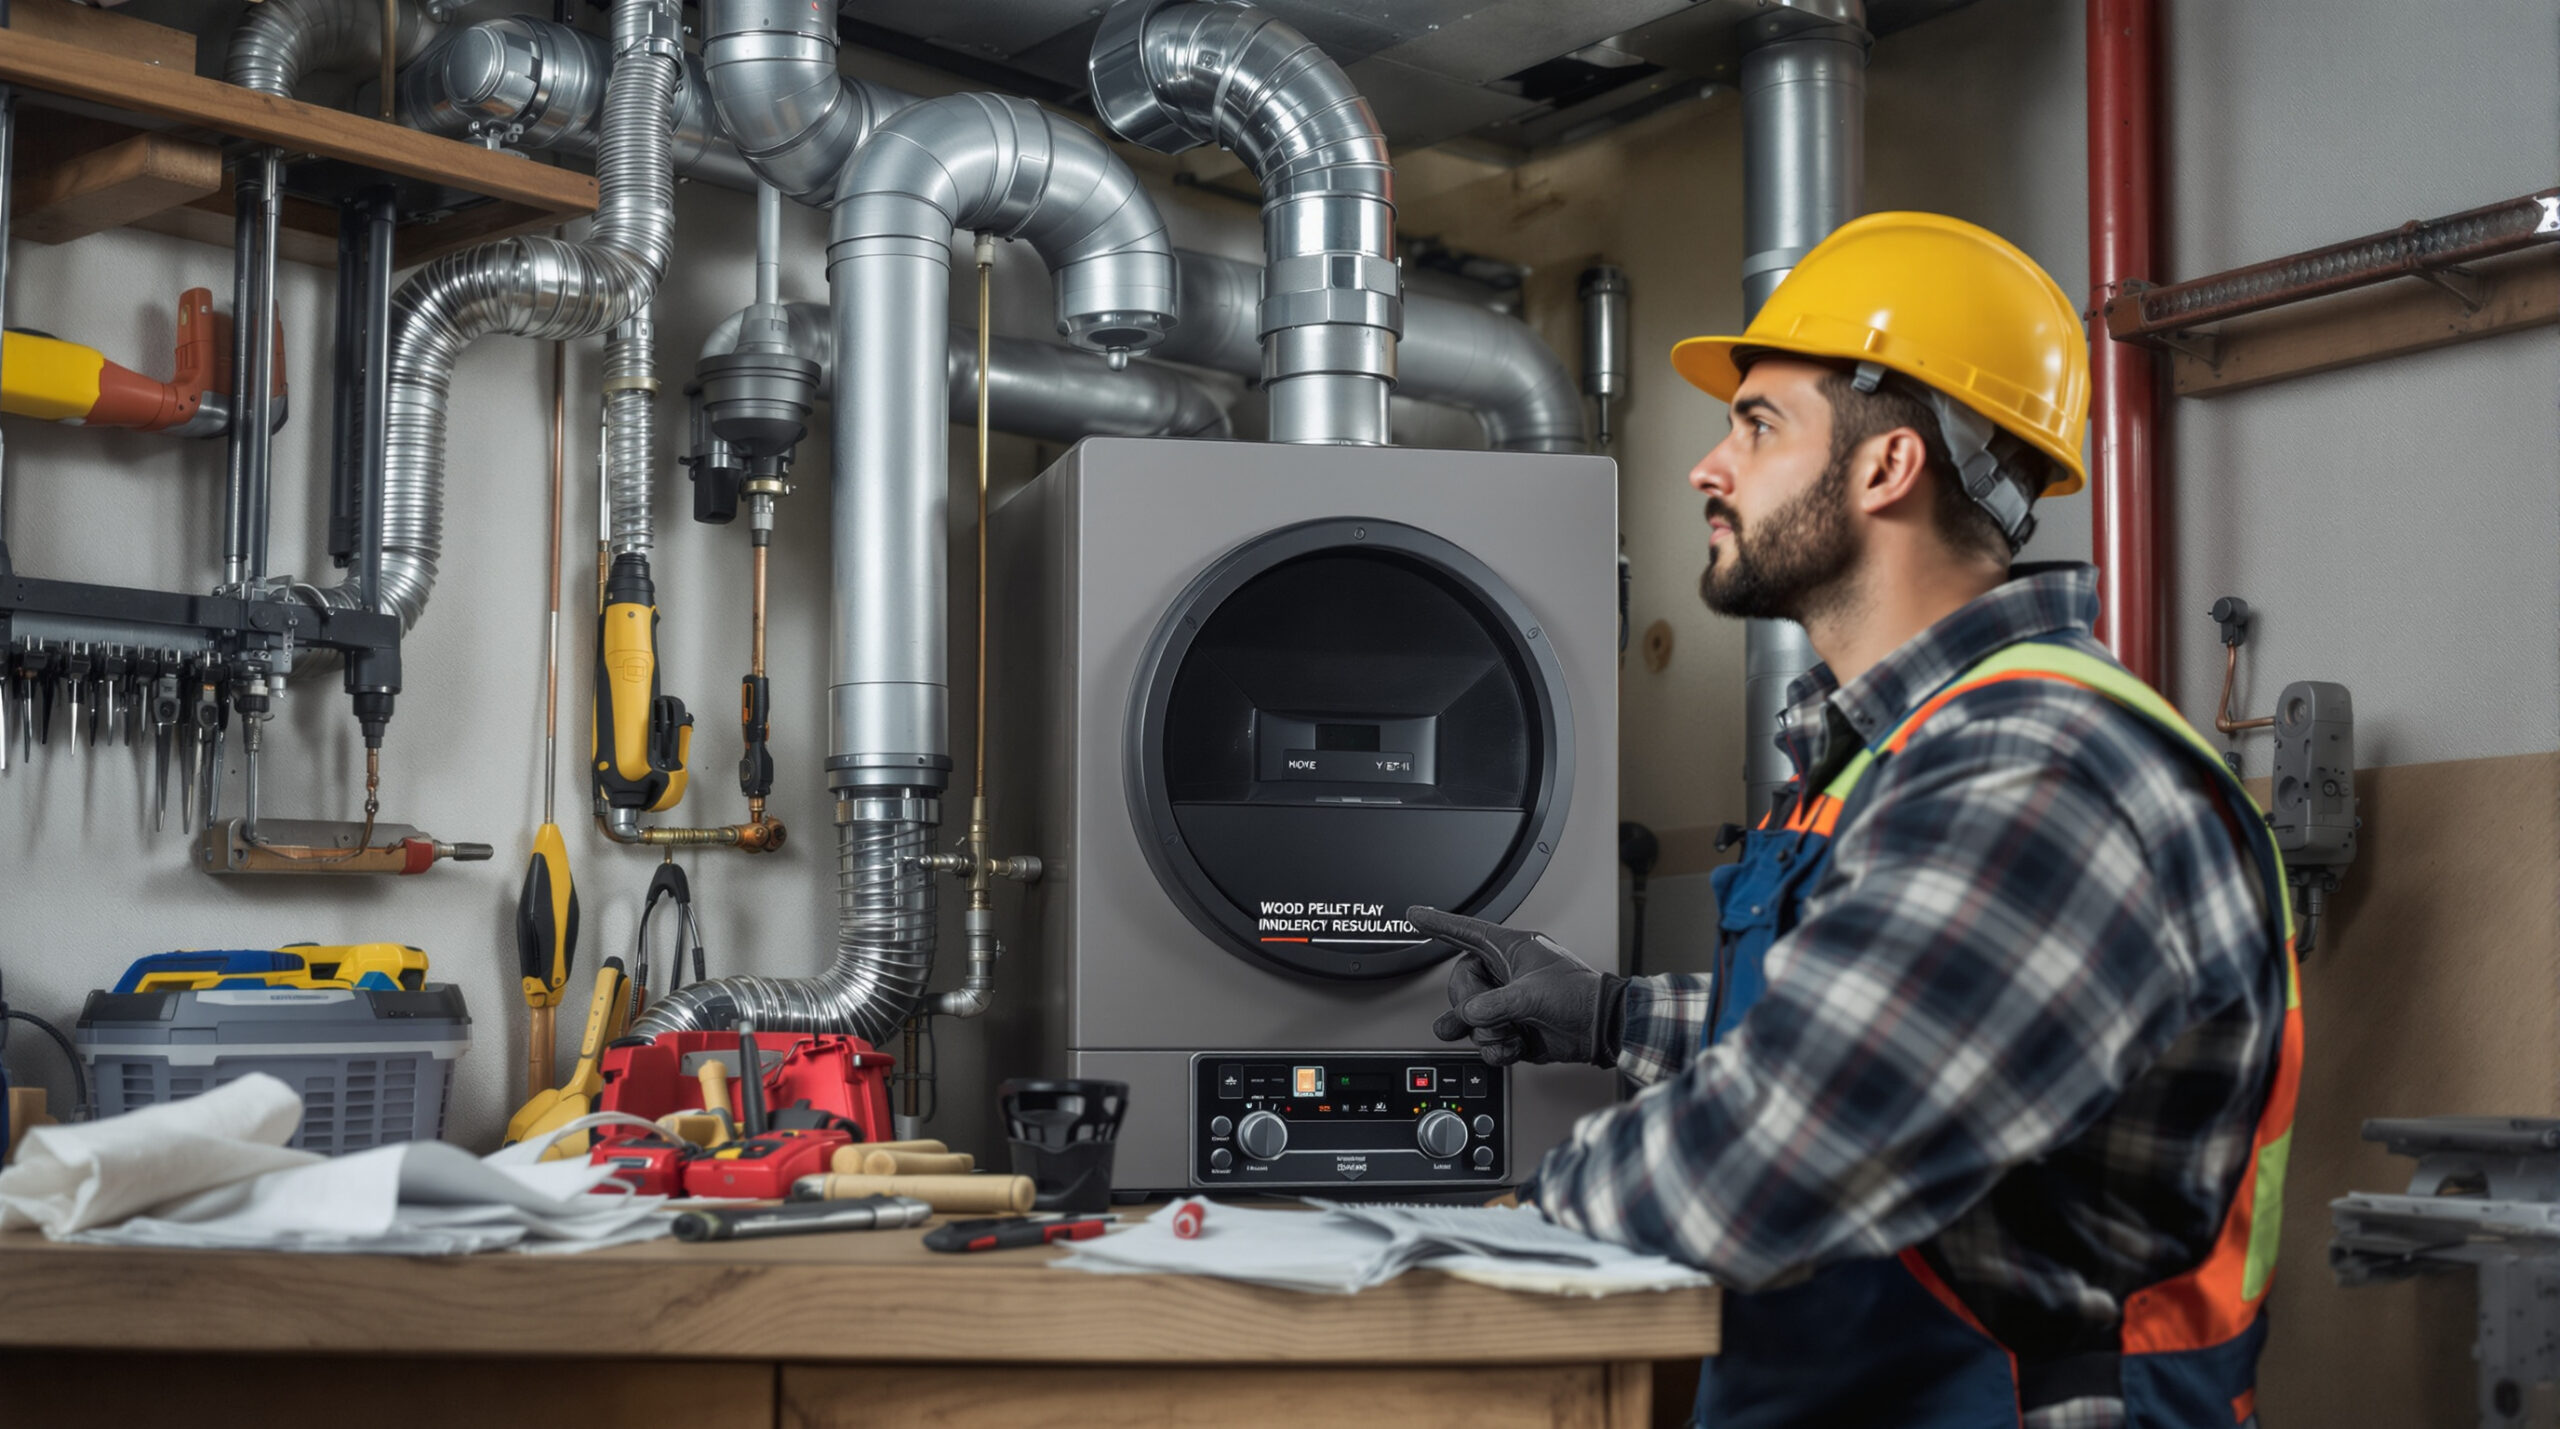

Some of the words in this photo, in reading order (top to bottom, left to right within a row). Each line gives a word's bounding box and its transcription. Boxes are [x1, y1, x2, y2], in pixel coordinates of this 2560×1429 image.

[1260, 901, 1305, 916] WOOD
[1308, 902, 1351, 916] PELLET
[1353, 903, 1385, 917] FLAY
